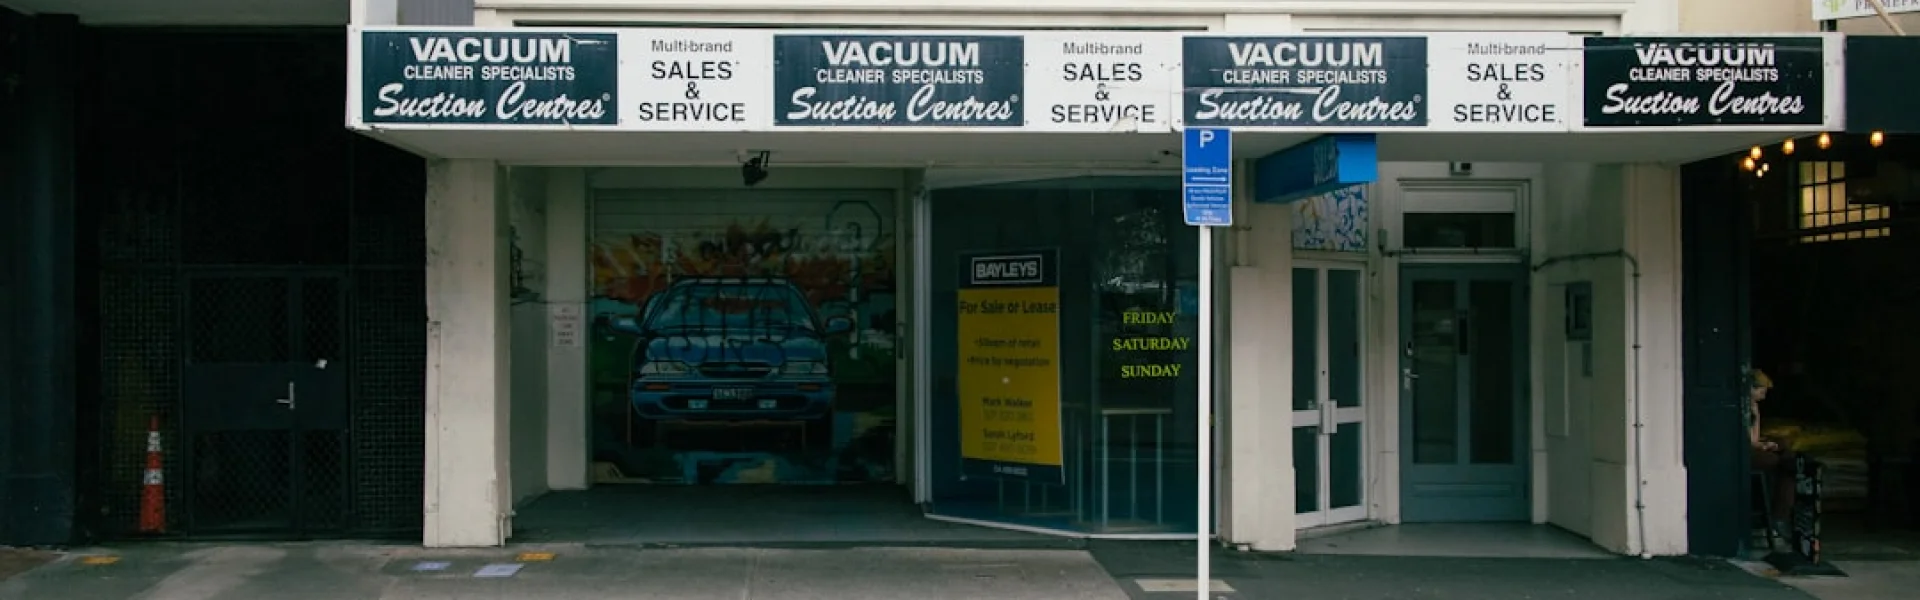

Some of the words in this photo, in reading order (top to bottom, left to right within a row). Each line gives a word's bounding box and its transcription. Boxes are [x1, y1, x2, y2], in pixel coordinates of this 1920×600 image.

[410, 38, 571, 63] VACUUM
[822, 41, 979, 66] VACUUM
[1228, 43, 1382, 67] VACUUM
[1633, 43, 1775, 66] VACUUM
[404, 66, 473, 81] CLEANER
[481, 66, 575, 81] SPECIALISTS
[651, 61, 732, 80] SALES
[817, 69, 884, 84] CLEANER
[892, 69, 984, 84] SPECIALISTS
[1063, 63, 1142, 82] SALES
[1223, 69, 1289, 84] CLEANER
[1297, 69, 1387, 84] SPECIALISTS
[1467, 64, 1545, 82] SALES
[1629, 68, 1690, 82] CLEANER
[1696, 68, 1779, 82] SPECIALISTS
[373, 83, 486, 117] Suction
[685, 82, 700, 100] &
[1094, 84, 1110, 101] &
[1497, 84, 1512, 100] &
[1602, 83, 1700, 115] Suction
[1708, 81, 1805, 115] Centres
[639, 103, 746, 122] SERVICE
[787, 87, 897, 120] Suction
[1195, 87, 1303, 120] Suction
[1051, 105, 1156, 124] SERVICE
[1453, 105, 1556, 123] SERVICE
[1199, 130, 1215, 149] P
[975, 261, 1038, 279] BAYLEYS
[959, 301, 979, 314] For
[981, 300, 1004, 314] Sale
[1022, 300, 1057, 314] Lease
[1123, 311, 1176, 324] FRIDAY
[1112, 337, 1190, 351] SATURDAY
[1121, 364, 1181, 378] SUNDAY
